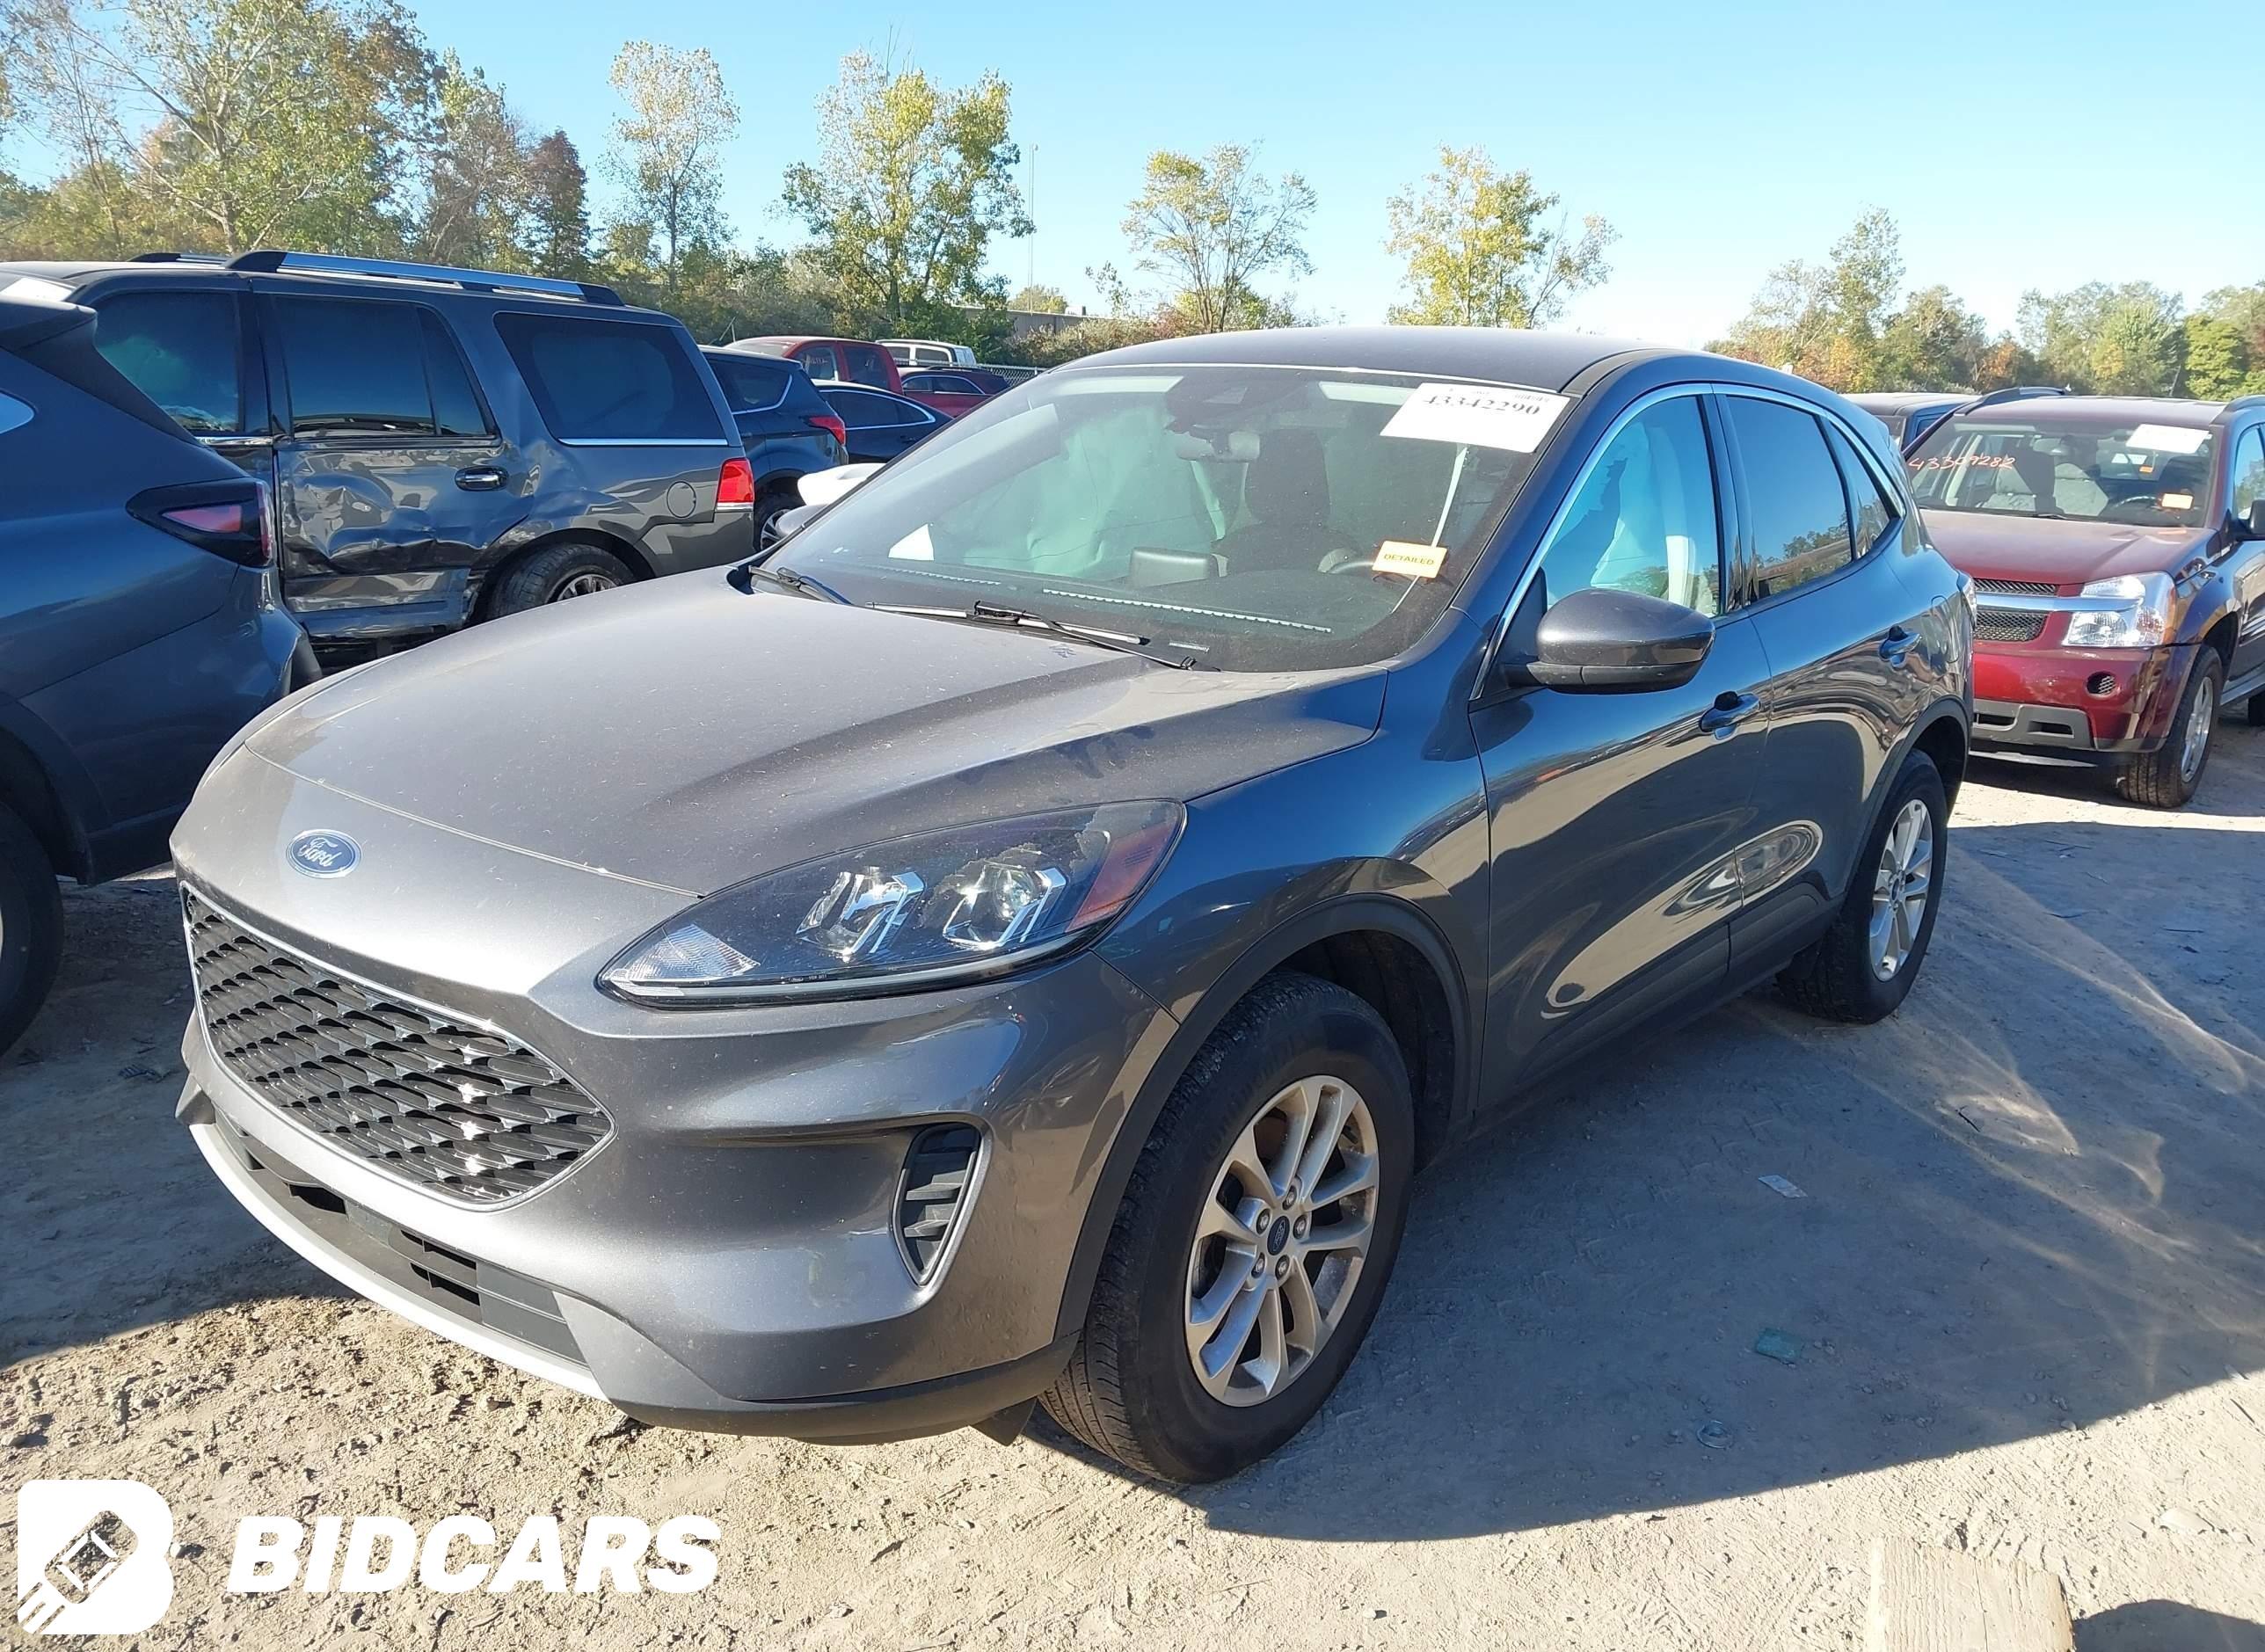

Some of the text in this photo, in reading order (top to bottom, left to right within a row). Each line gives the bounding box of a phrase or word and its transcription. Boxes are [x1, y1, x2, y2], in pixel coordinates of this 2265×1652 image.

[1423, 396, 1540, 415] 43342290
[1383, 553, 1435, 565] DETAILED
[298, 837, 341, 867] Ford
